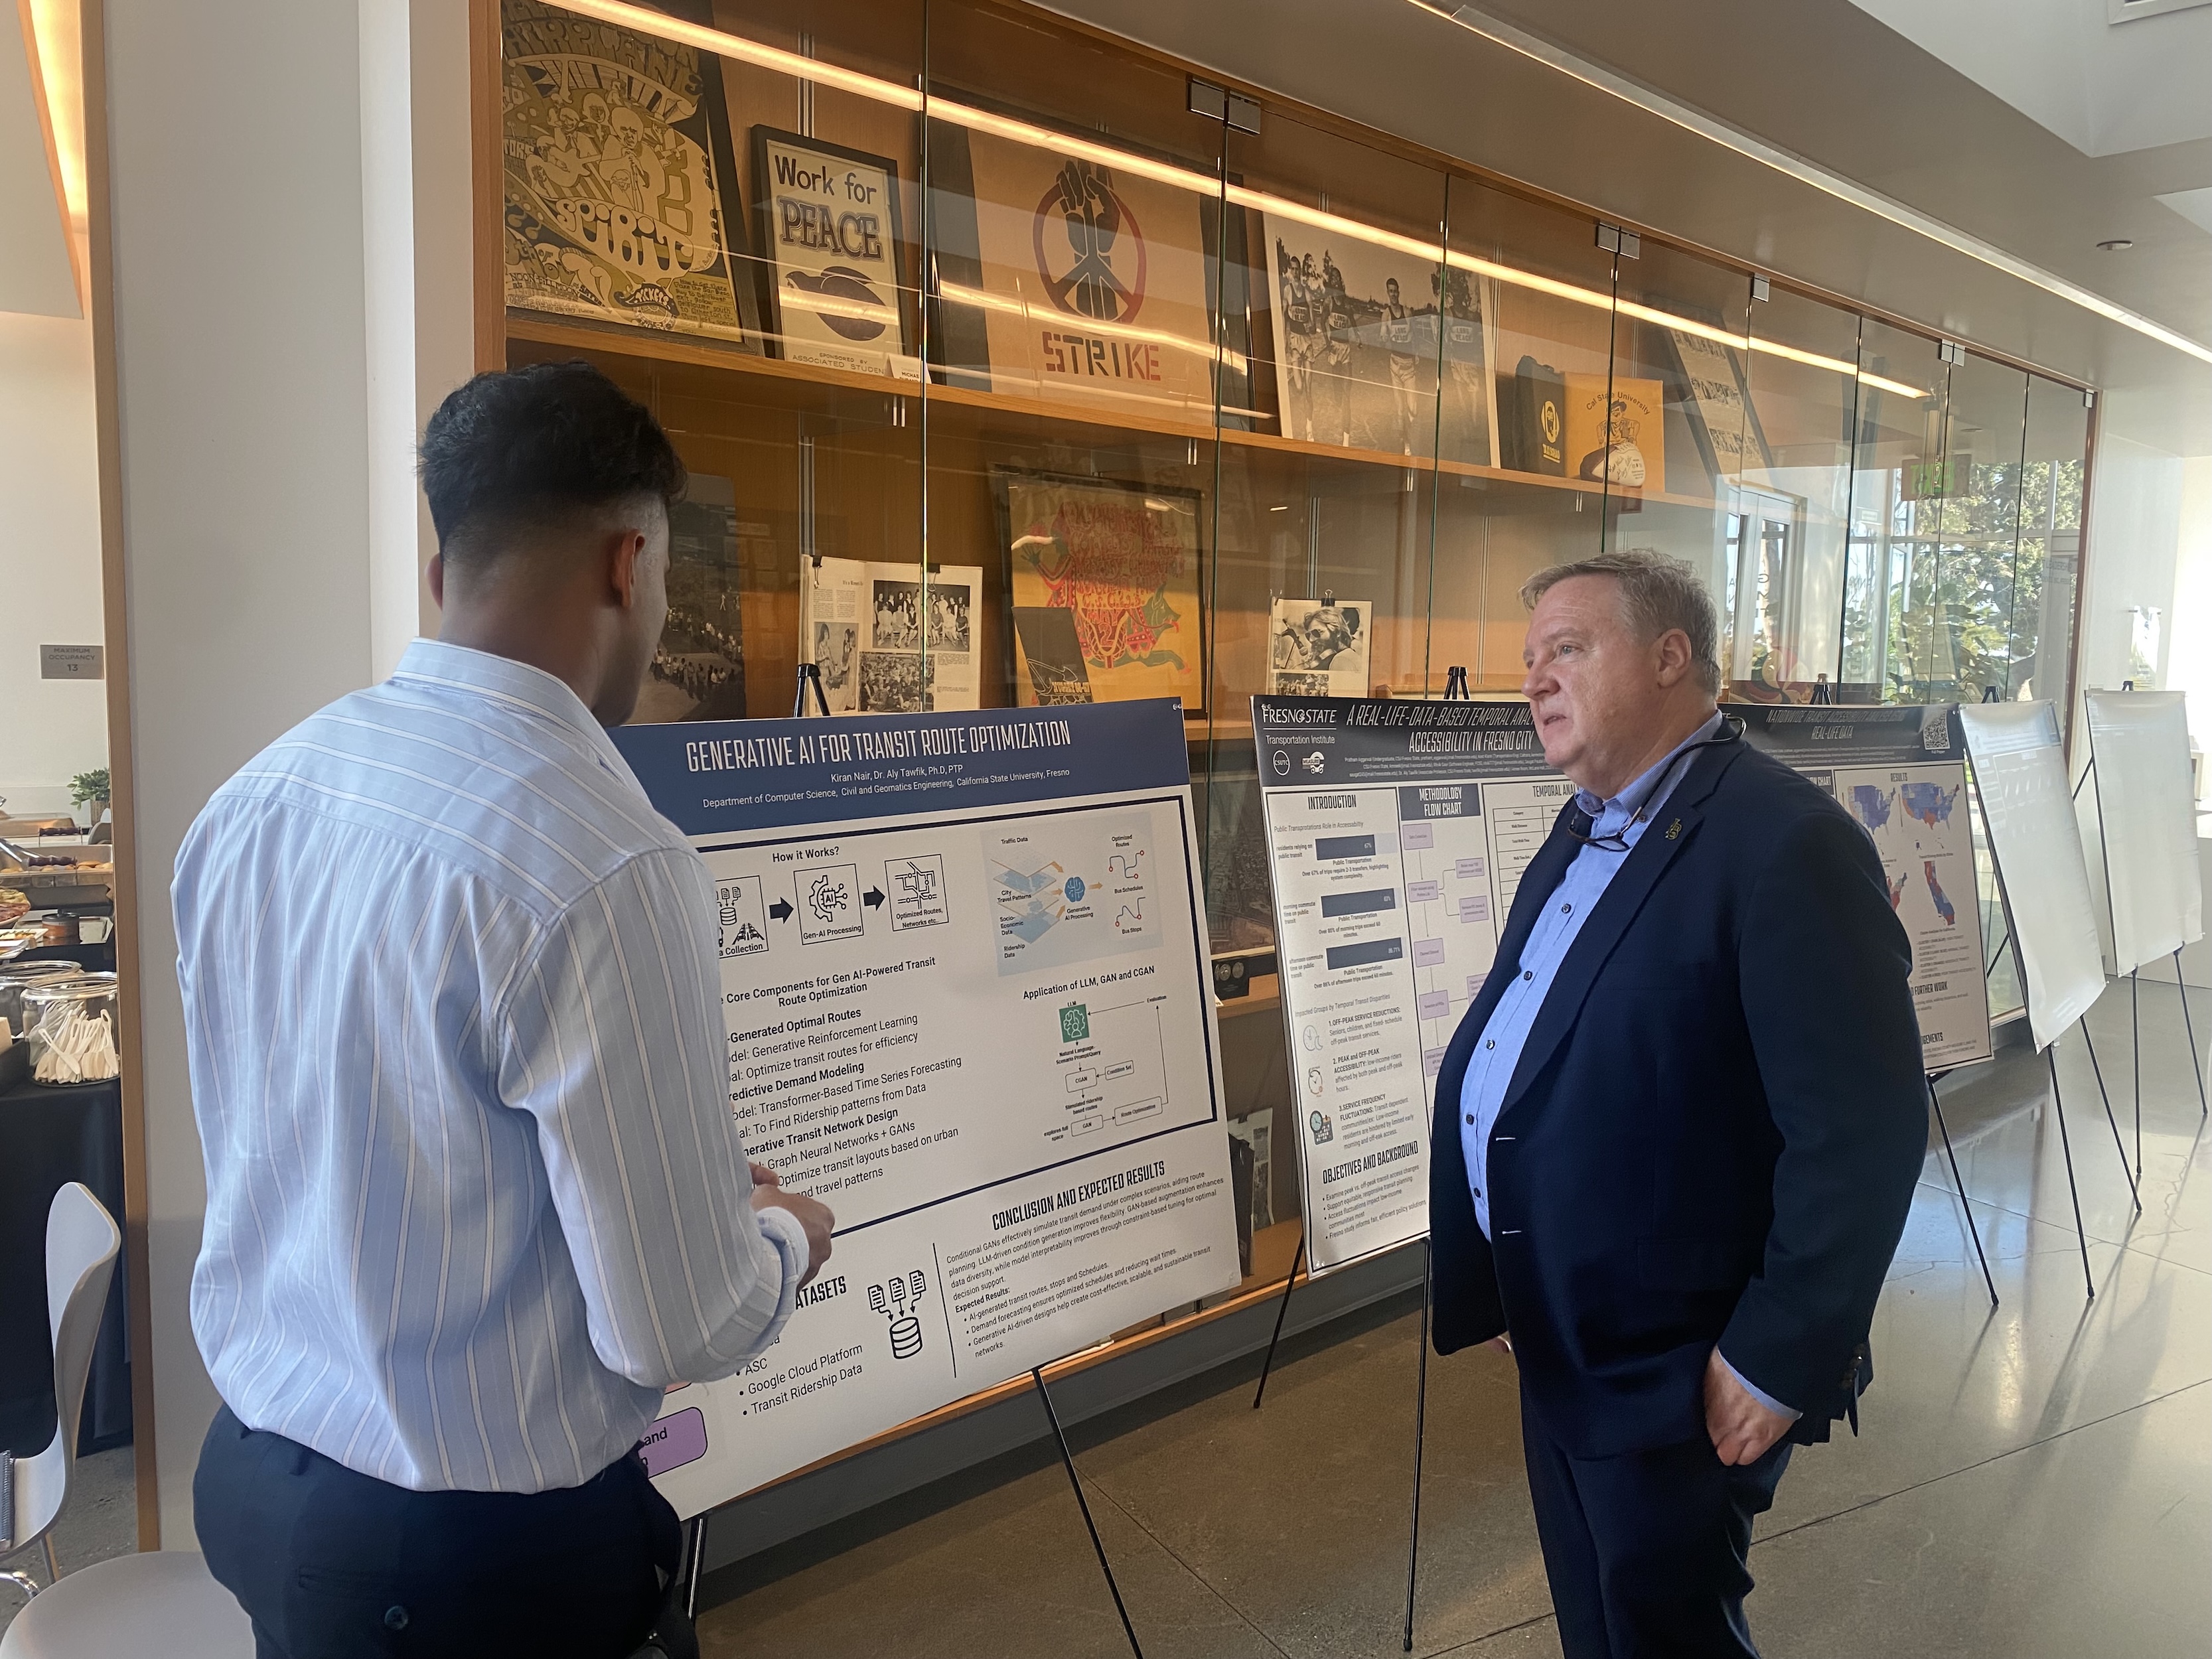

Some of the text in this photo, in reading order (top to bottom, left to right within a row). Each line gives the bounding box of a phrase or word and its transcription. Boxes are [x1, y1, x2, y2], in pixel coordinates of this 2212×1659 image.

[775, 155, 877, 204] Work for
[777, 196, 884, 262] PEACE
[793, 355, 884, 375] ASSOCIATED STUDEN
[820, 353, 854, 362] SPONSORED
[1043, 332, 1161, 382] STRIKE
[1586, 399, 1597, 410] Cal
[1617, 392, 1650, 415] University
[1347, 704, 1534, 726] A REAL-LIFE-DATA-BASED TEMPORAL ANAL
[686, 720, 1071, 772] GENERATIVE AI FOR TRANSIT ROUTE OPTIMIZATION
[1266, 735, 1335, 746] Transportation Institute
[1409, 730, 1534, 753] ACCESSIBILITY IN FRESNO CITY
[831, 764, 963, 782] Kiran Nair, Dr. Aly Tawfik, Ph.D, PTP
[1891, 772, 1907, 782] RESULTS
[703, 796, 753, 808] Department
[755, 794, 763, 803] of
[765, 791, 804, 803] Computer
[806, 790, 838, 799] Science,
[842, 786, 857, 796] Civil
[859, 785, 872, 794] and
[873, 783, 913, 794] Geomatics
[914, 780, 954, 791] Engineering,
[957, 776, 989, 786] California
[1010, 771, 1045, 782] University,
[1047, 768, 1070, 778] Fresno
[1419, 786, 1462, 801] METHODOLOGY
[1532, 784, 1577, 797] TEMPORAL ANAL
[1308, 794, 1357, 810] INTRODUCTION
[1424, 802, 1462, 816] FLOW CHART
[773, 846, 840, 863] How it Works?
[825, 894, 834, 903] AI
[897, 910, 922, 920] Optimized
[903, 919, 926, 928] Networks
[803, 925, 861, 940] Gen-AI Processing
[725, 943, 763, 955] Collection
[726, 957, 936, 1003] Core Components for Gen AI-Powered Transit
[1023, 966, 1155, 1001] Application of LLM, GAN and CGAN
[1915, 981, 1948, 995] FURTHER WORK
[778, 983, 867, 1007] Route Optimization
[787, 1009, 861, 1034] Optimal Routes
[1355, 1012, 1372, 1021] SERVICE
[1373, 1007, 1400, 1017] REDUCTIONS:
[752, 1015, 918, 1058] Generative Reinforcement Learning
[746, 1032, 918, 1080] Optimize transit routes for efficiency
[760, 1056, 962, 1114] Transformer-Based Time Series Forecasting
[776, 1062, 864, 1091] Demand Modeling
[1361, 1094, 1386, 1106] FREQUENCY
[1323, 1141, 1418, 1184] OBJECTIVES AND BACKGROUND
[992, 1161, 1165, 1230] CONCLUSION AND EXPECTED RESULTS
[946, 1246, 982, 1263] Conditional
[983, 1240, 1001, 1250] GANs
[1002, 1229, 1032, 1244] effectively
[1033, 1220, 1058, 1233] simulate
[1060, 1213, 1078, 1224] transit
[1080, 1202, 1102, 1217] demand
[1104, 1199, 1118, 1209] under
[1120, 1192, 1143, 1203] complex
[1144, 1183, 1171, 1194] scenarios,
[1173, 1177, 1189, 1187] aiding
[796, 1275, 847, 1309] ATASETS
[745, 1358, 768, 1376] ASC
[748, 1343, 863, 1396] Google Cloud Platform
[751, 1364, 863, 1415] Transit Ridership Data
